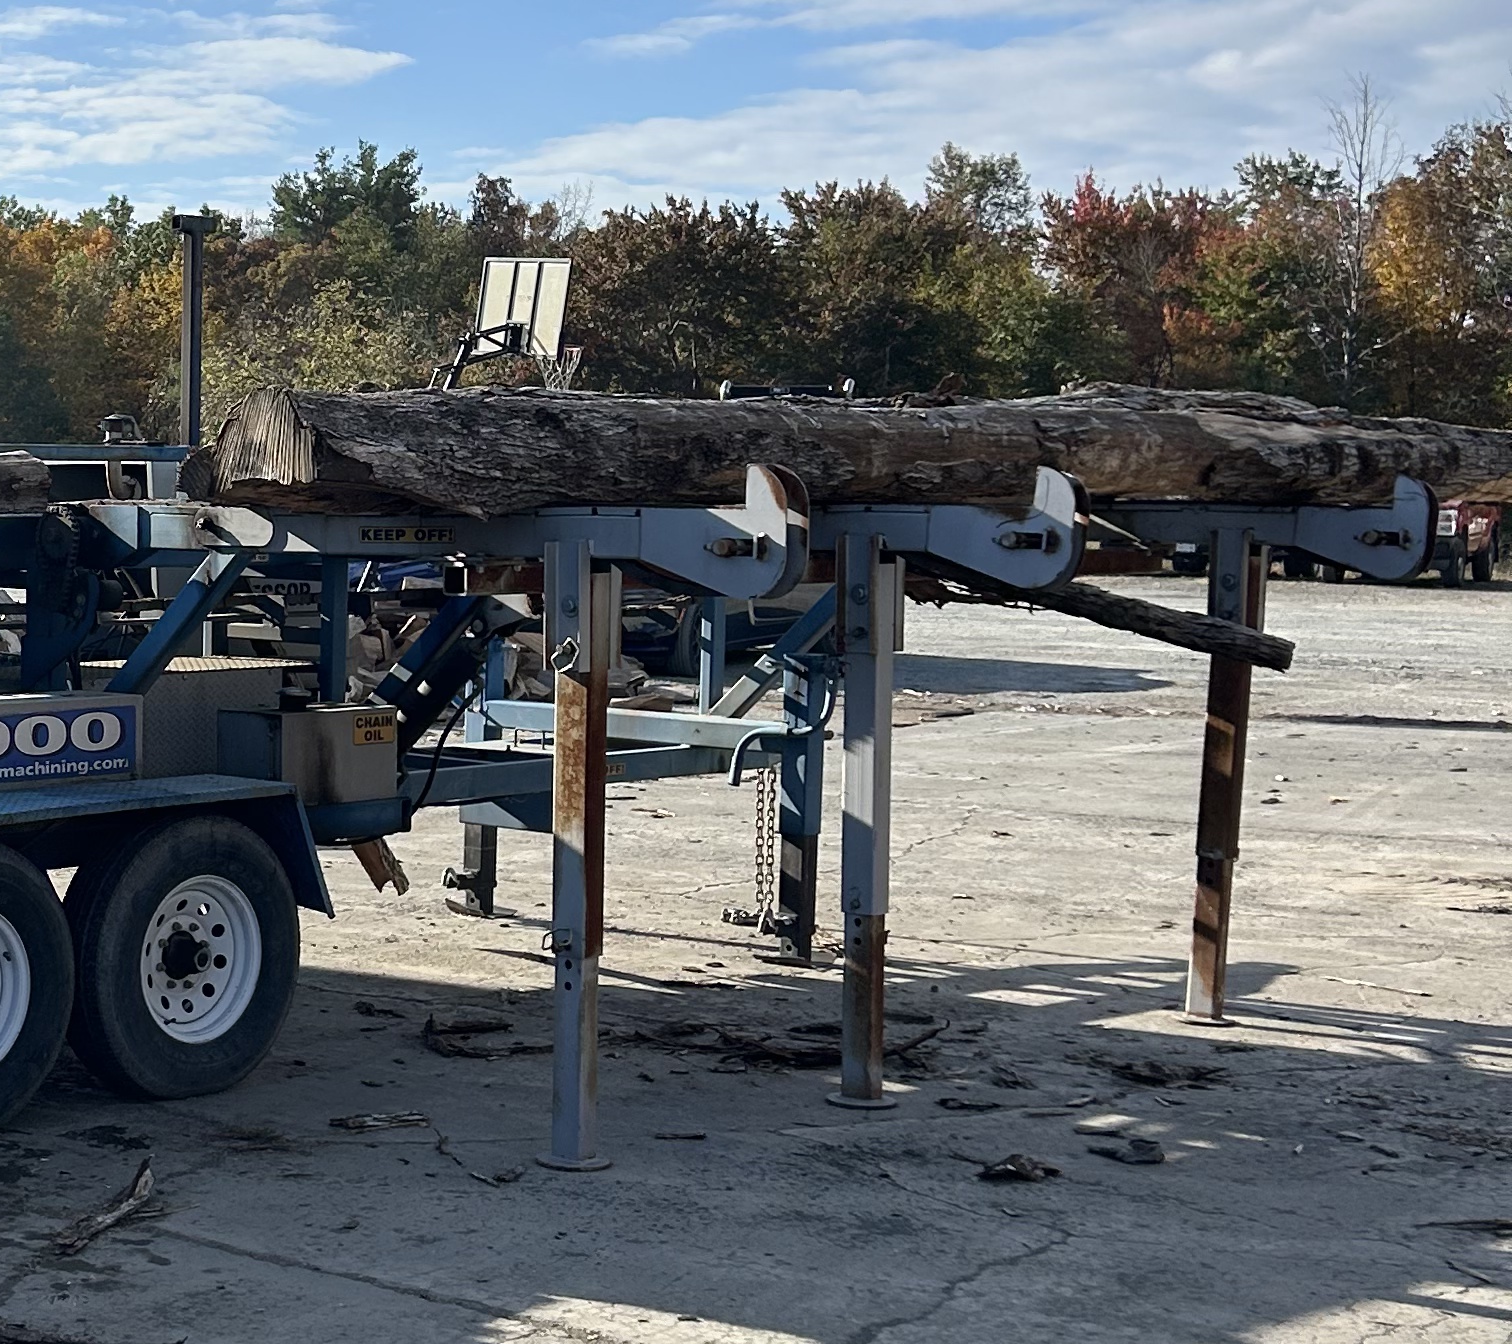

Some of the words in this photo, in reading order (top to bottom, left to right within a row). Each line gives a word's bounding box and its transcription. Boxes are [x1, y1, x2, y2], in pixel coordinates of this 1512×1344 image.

[361, 528, 406, 541] KEEP
[414, 528, 453, 541] OFF!
[356, 716, 393, 729] CHAIN
[364, 729, 385, 741] OIL
